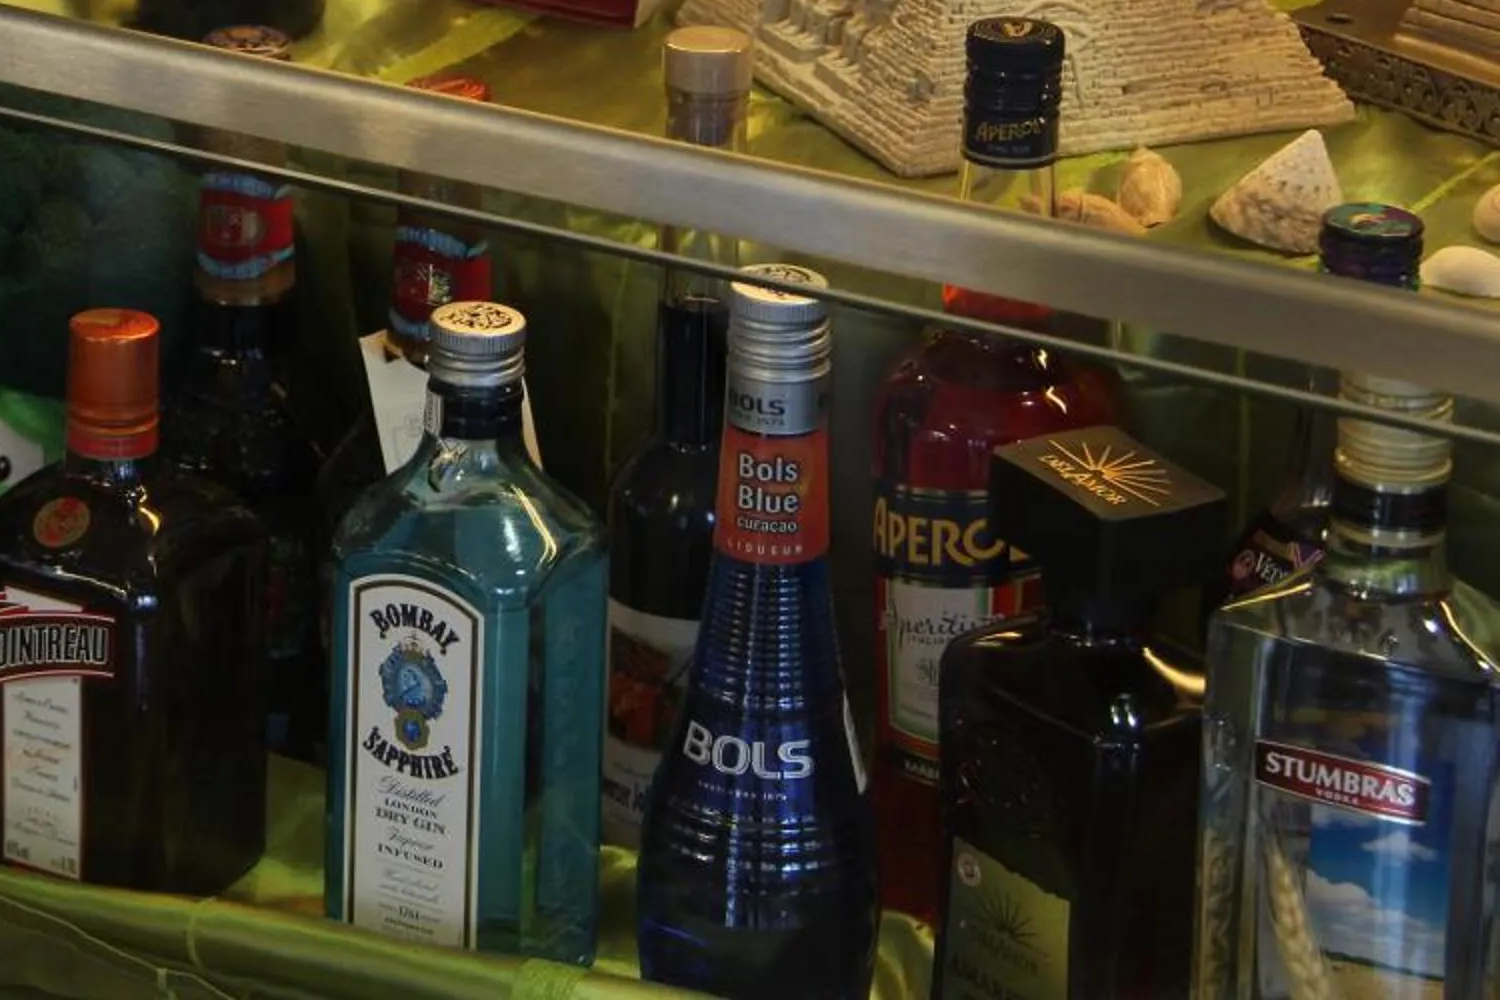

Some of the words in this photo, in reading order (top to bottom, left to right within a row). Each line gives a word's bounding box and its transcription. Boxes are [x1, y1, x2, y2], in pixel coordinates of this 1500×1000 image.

[739, 453, 798, 482] Bols
[738, 485, 799, 513] Blue
[873, 496, 1030, 568] APERO
[726, 538, 804, 557] LIQUEUR
[369, 602, 460, 656] BOMBAY
[362, 726, 459, 780] SAPPHIRE
[682, 719, 817, 781] BOLS
[1265, 750, 1417, 808] STUMBRAS
[376, 807, 408, 825] DRY
[413, 818, 447, 836] GIN
[384, 798, 438, 819] LONDON
[377, 843, 444, 870] INFUSED
